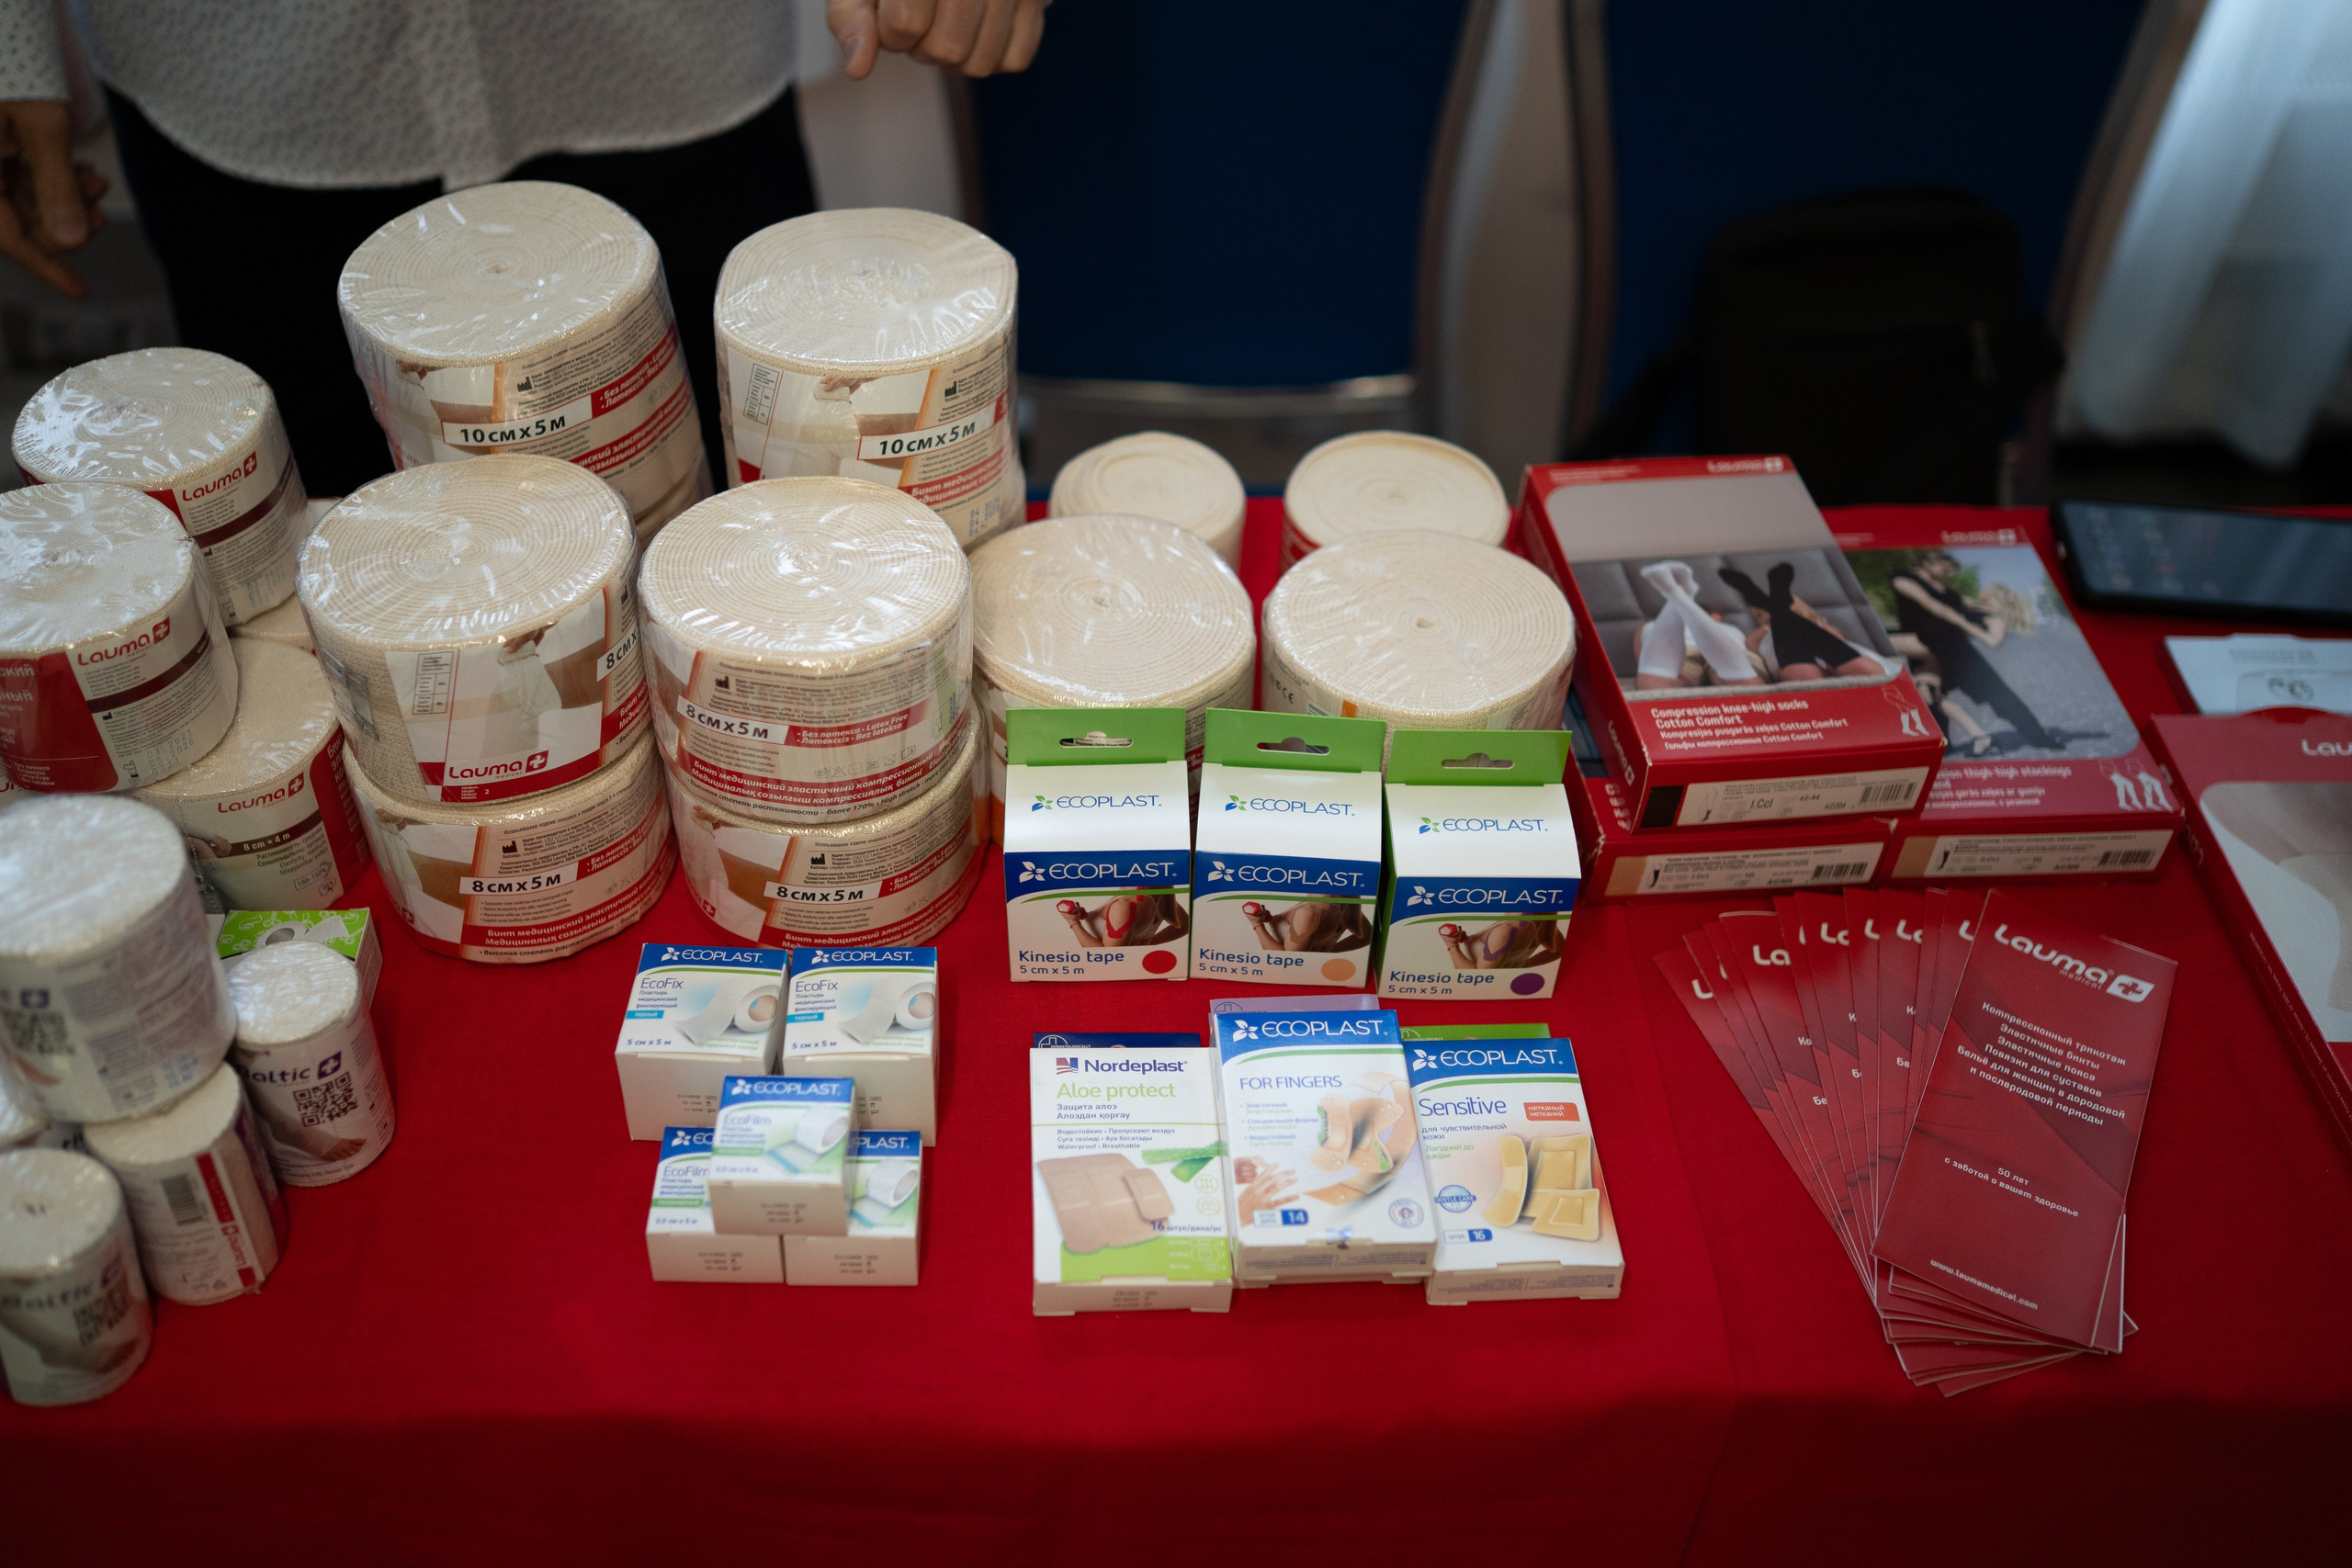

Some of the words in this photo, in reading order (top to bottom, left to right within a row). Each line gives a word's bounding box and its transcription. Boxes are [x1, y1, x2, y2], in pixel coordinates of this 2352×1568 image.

[460, 428, 485, 443] 10
[535, 419, 547, 435] 5
[880, 439, 903, 455] 10
[949, 425, 959, 442] 5
[182, 468, 242, 502] Lauma
[77, 634, 151, 666] Lauma
[1652, 704, 1721, 720] Compression
[1722, 701, 1776, 716] knee-high
[1778, 699, 1809, 711] socks
[686, 705, 695, 718] 8
[738, 722, 750, 736] 5
[820, 728, 861, 739] латекса
[866, 719, 889, 731] Latex
[890, 712, 909, 723] Free
[1656, 718, 1694, 729] Cotton
[1697, 714, 1743, 727] Comfort
[801, 736, 849, 744] Латекссіз
[855, 732, 871, 740] Bez
[872, 723, 902, 737] lateksa
[448, 761, 523, 779] Lauma
[495, 772, 523, 780] medical
[694, 760, 718, 776] Бинт
[718, 773, 786, 791] медицинский
[786, 784, 854, 795] эластичный
[856, 753, 933, 791] компрессионный
[218, 788, 285, 813] Lauma
[1057, 795, 1159, 808] ECOPLAST
[1250, 798, 1352, 816] ECOPLAST
[1443, 818, 1544, 831] ECOPLAST
[243, 843, 250, 852] 8
[252, 841, 265, 850] cm
[1049, 863, 1173, 879] ECOPLAST
[1238, 866, 1363, 886] ECOPLAST
[472, 880, 483, 893] 8
[532, 876, 541, 889] 5
[776, 886, 788, 897] 8
[833, 889, 844, 901] 5
[1439, 888, 1563, 904] ECOPLAST
[517, 917, 583, 937] медицинский
[585, 886, 639, 920] эластичный
[485, 934, 557, 947] Медициналық
[519, 947, 554, 956] степень
[555, 924, 615, 953] растяжимости
[785, 932, 812, 943] Бинт
[814, 931, 879, 945] медицинский
[682, 949, 763, 964] ECOPLAST
[831, 951, 912, 962] ECOPLAST
[1019, 951, 1080, 962] Kinesio
[1087, 952, 1125, 964] tape
[1200, 948, 1261, 964] Kinesio
[1267, 953, 1304, 968] tape
[1995, 924, 2108, 985] Lauma
[1199, 963, 1205, 971] 5
[1209, 965, 1227, 974] cm
[640, 977, 684, 989] EcoFix
[796, 979, 839, 993] EcoFix
[1389, 971, 1451, 984] Kinesio
[1457, 973, 1494, 986] tape
[2060, 970, 2103, 990] medical
[1388, 985, 1395, 993] 5
[1261, 1021, 1384, 1037] ECOPLAST
[1982, 1001, 2073, 1046] Компрессионный
[2075, 1042, 2126, 1066] трикотаж
[2000, 1023, 2064, 1055] Эластичные
[2067, 1052, 2099, 1069] бинты
[1441, 1049, 1557, 1066] ECOPLAST
[1997, 1036, 2062, 1068] Эластичные
[2064, 1065, 2096, 1081] пояса
[1085, 1059, 1184, 1075] Nordeplast
[1984, 1043, 2029, 1068] Повязки
[2030, 1066, 2050, 1077] для
[2053, 1073, 2102, 1097] суставов
[753, 1081, 841, 1095] ECOPLAST
[1240, 1077, 1273, 1090] FOR
[1276, 1075, 1342, 1089] FINGERS
[1957, 1045, 1989, 1065] Бельё
[1990, 1063, 2010, 1075] для
[2013, 1071, 2055, 1093] женщин
[2067, 1094, 2125, 1119] дородовой
[1057, 1083, 1102, 1099] Aloe
[1106, 1083, 1176, 1101] protect
[1970, 1066, 1977, 1075] и
[1979, 1071, 2053, 1106] послеродовой
[2056, 1102, 2103, 1126] периоды
[1057, 1103, 1092, 1111] Защита
[1419, 1097, 1507, 1117] Sensitive
[1440, 1123, 1507, 1133] чувствительной
[1425, 1145, 1462, 1153] Лагідний
[1997, 1168, 2011, 1178] 50
[2012, 1175, 2030, 1186] лет
[1952, 1160, 1989, 1181] заботой
[1999, 1181, 2032, 1200] вашем
[2034, 1195, 2079, 1217] здоровье
[1288, 1212, 1306, 1224] 14
[1930, 1258, 2039, 1311] www.laumamedical.com
